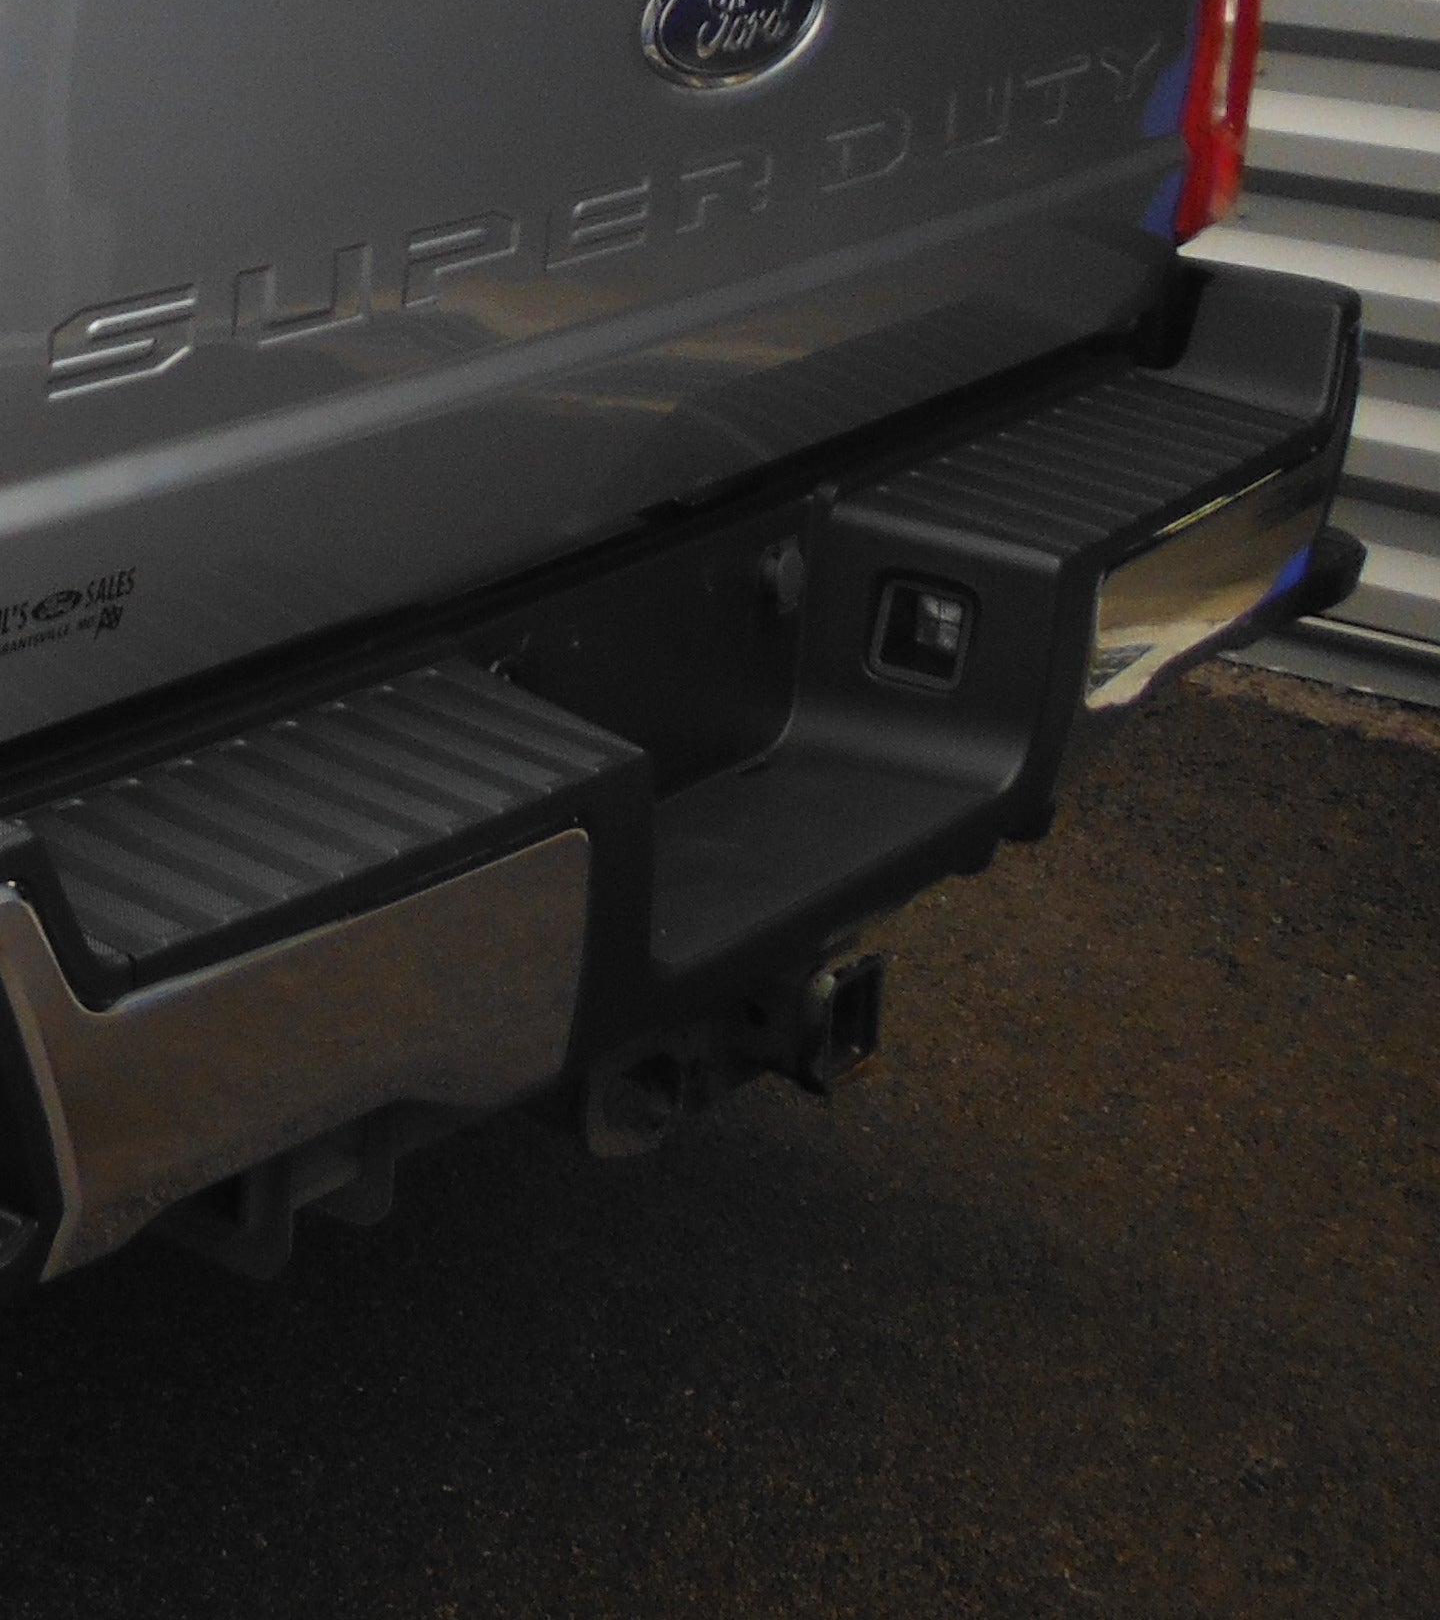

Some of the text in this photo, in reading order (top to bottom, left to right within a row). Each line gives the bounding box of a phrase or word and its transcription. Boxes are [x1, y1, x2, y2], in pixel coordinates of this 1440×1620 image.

[47, 39, 1161, 401] SUPER DUTY
[85, 566, 136, 608] SALES
